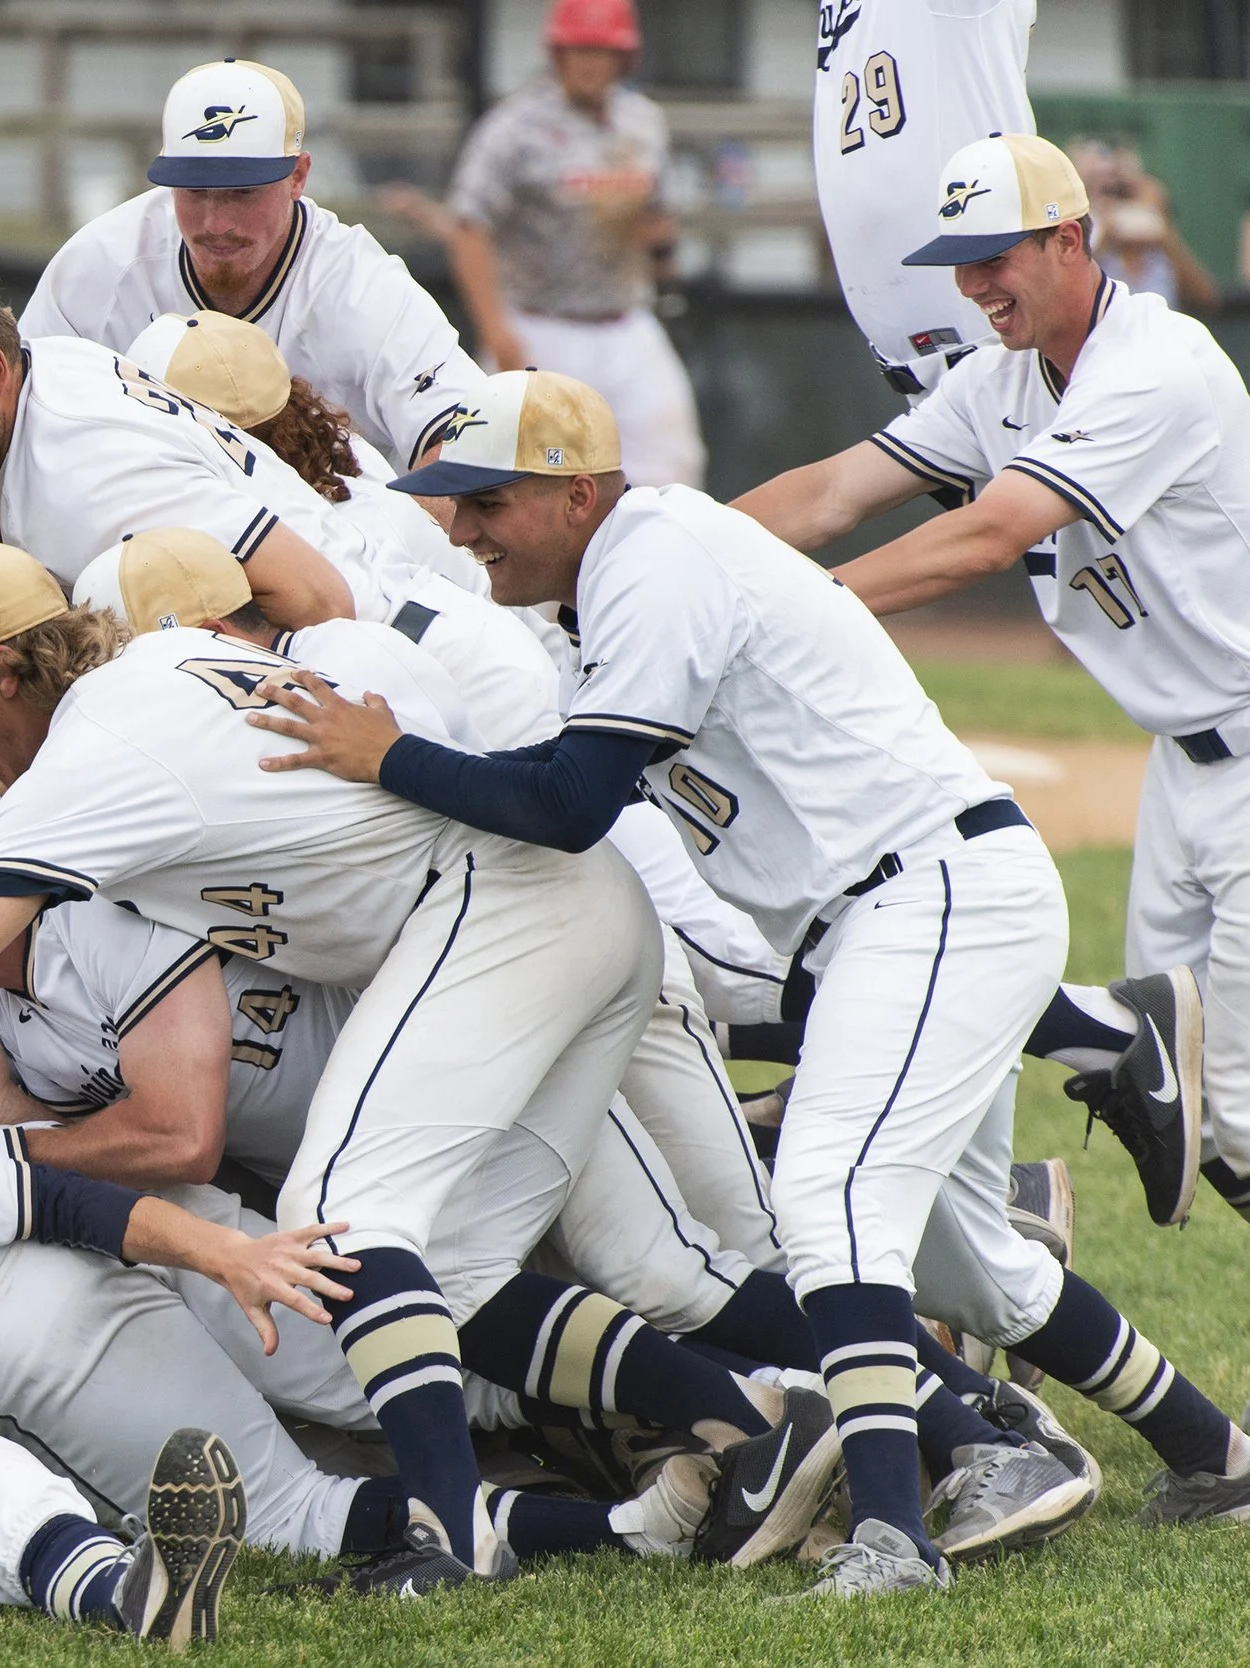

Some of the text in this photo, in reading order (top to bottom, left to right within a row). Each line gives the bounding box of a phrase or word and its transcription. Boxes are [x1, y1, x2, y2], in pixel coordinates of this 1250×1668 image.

[840, 50, 907, 156] 29
[1069, 553, 1149, 629] 17
[661, 763, 740, 856] 10
[200, 882, 289, 961] 44
[231, 984, 301, 1070] 14
